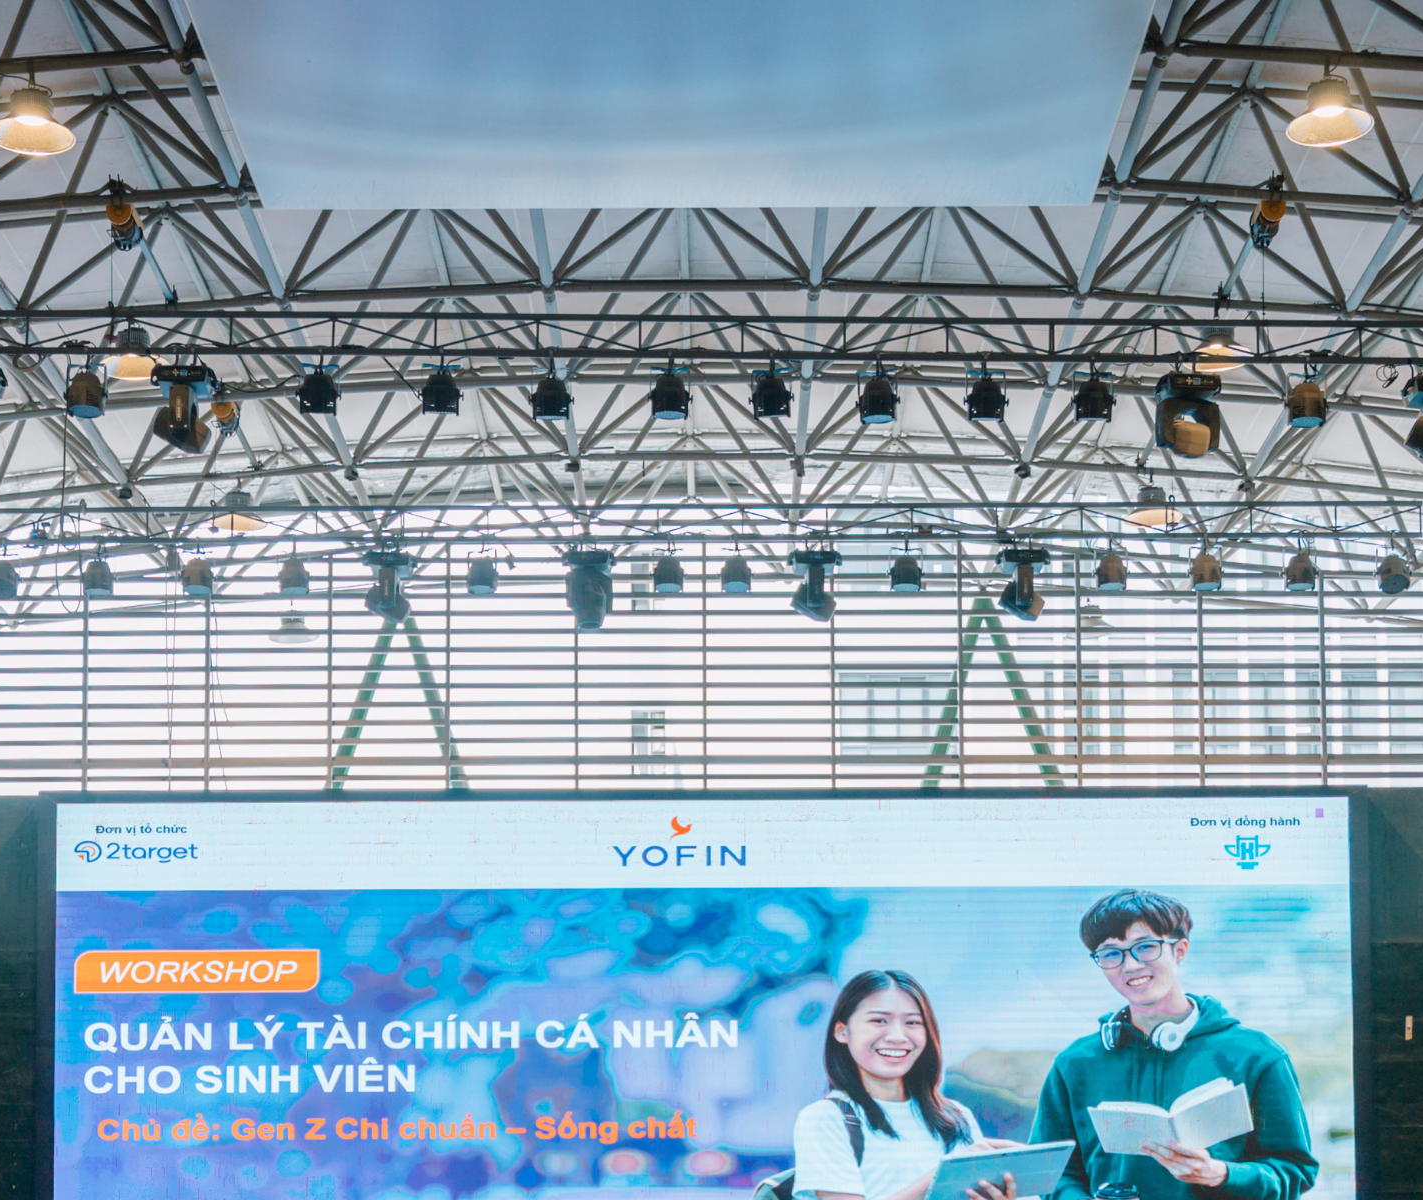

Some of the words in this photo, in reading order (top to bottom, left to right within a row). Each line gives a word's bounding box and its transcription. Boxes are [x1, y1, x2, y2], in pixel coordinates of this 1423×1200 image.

[95, 825, 122, 834] Đơn
[1190, 817, 1216, 827] Đơn
[1270, 816, 1301, 827] hành
[106, 842, 198, 863] 2target
[612, 845, 746, 867] YOFIN
[99, 960, 298, 984] WORKSHOP
[84, 1016, 212, 1054] QUẢN
[229, 1014, 284, 1051] LÝ
[297, 1014, 366, 1050] TÀI
[381, 1013, 520, 1050] CHÍNH
[535, 1013, 599, 1049] CÁ
[613, 1012, 738, 1048] NHÂN
[84, 1065, 181, 1094] CHO
[195, 1064, 299, 1094] SINH
[313, 1057, 415, 1093] VIÊN
[97, 1119, 161, 1141] Chủ
[171, 1113, 219, 1141] đề:
[231, 1118, 295, 1141] Gen
[304, 1118, 326, 1140] Z
[335, 1117, 388, 1140] Chi
[399, 1113, 497, 1140] chuẩn
[535, 1111, 618, 1144] Sống
[628, 1111, 697, 1139] chất
